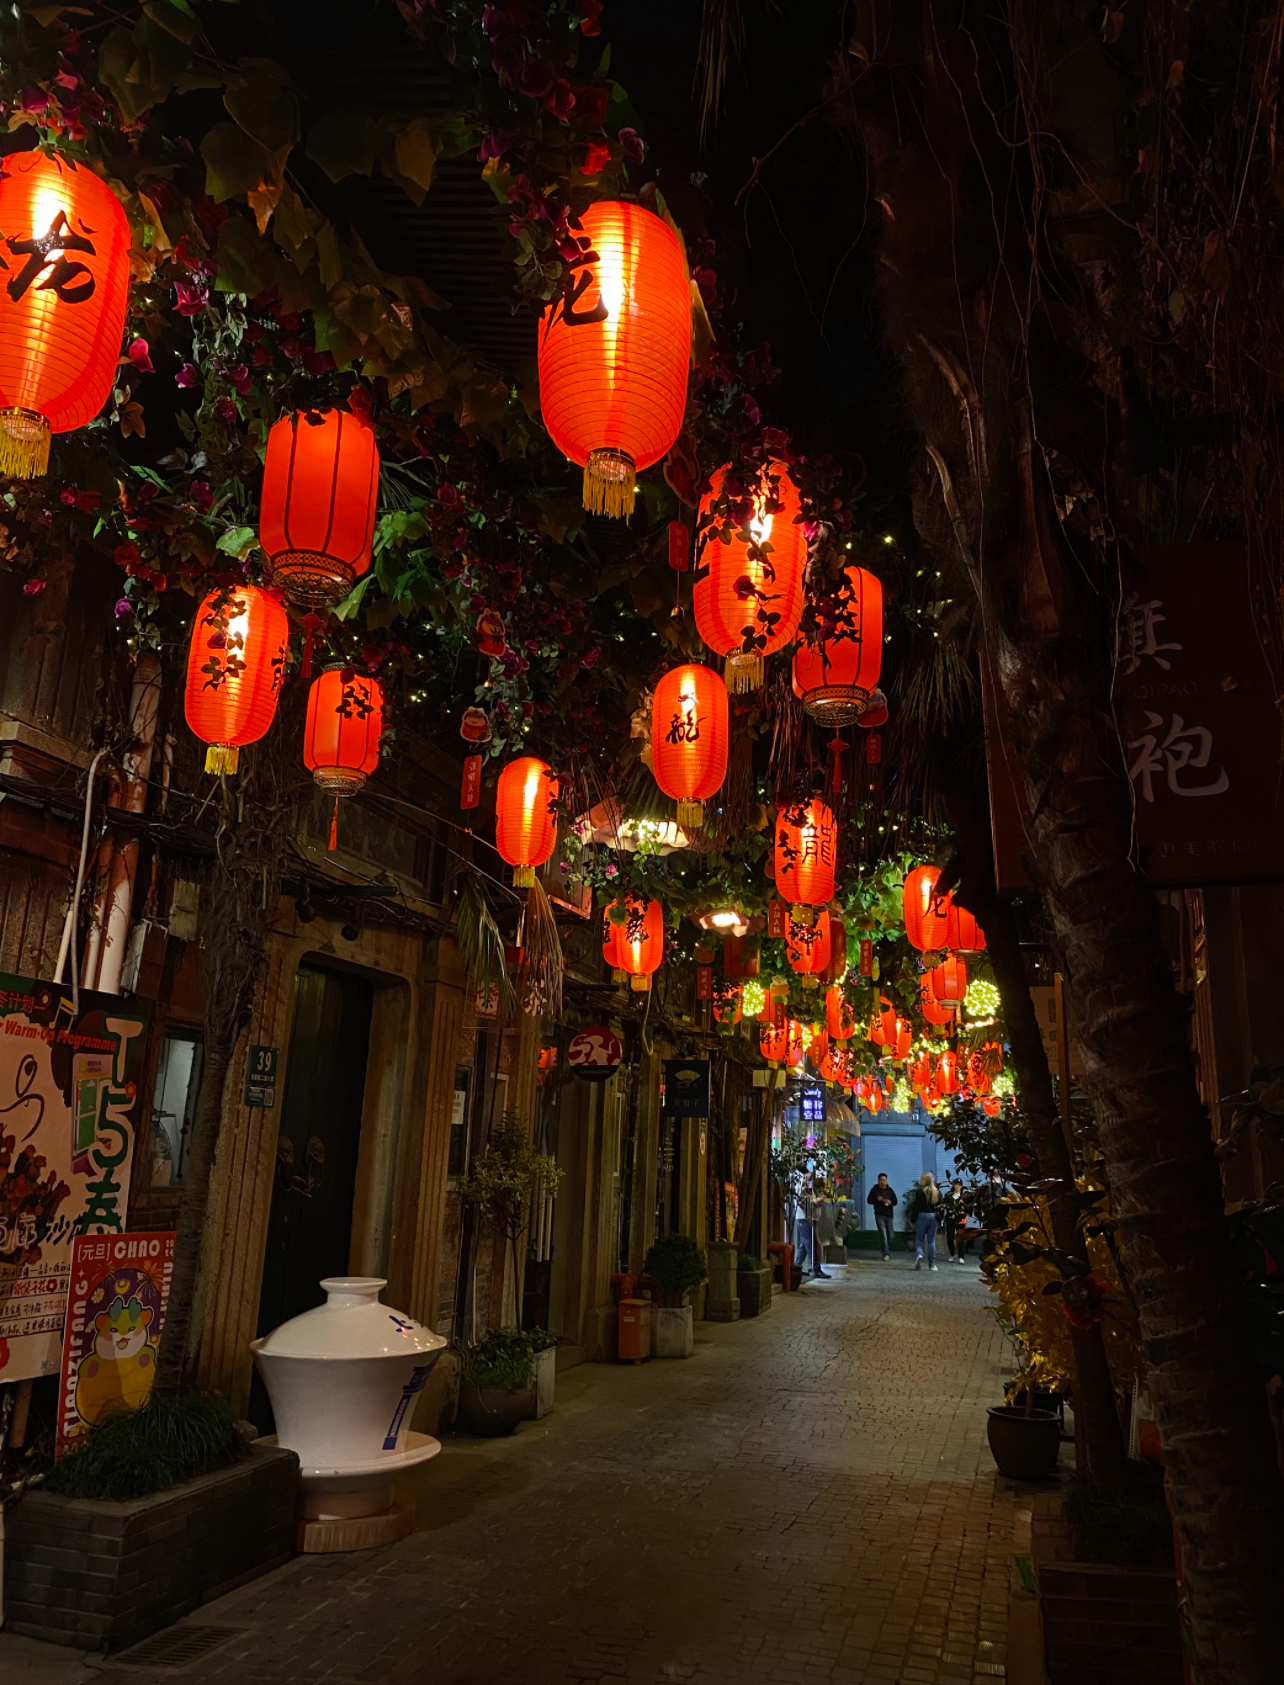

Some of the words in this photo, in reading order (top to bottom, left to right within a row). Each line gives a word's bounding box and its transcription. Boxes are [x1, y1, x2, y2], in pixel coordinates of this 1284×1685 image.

[1133, 681, 1198, 699] QIPAO
[1126, 709, 1231, 803] 袍
[57, 1028, 117, 1051] Programme
[257, 1051, 272, 1071] 39
[114, 1239, 160, 1259] CHAO
